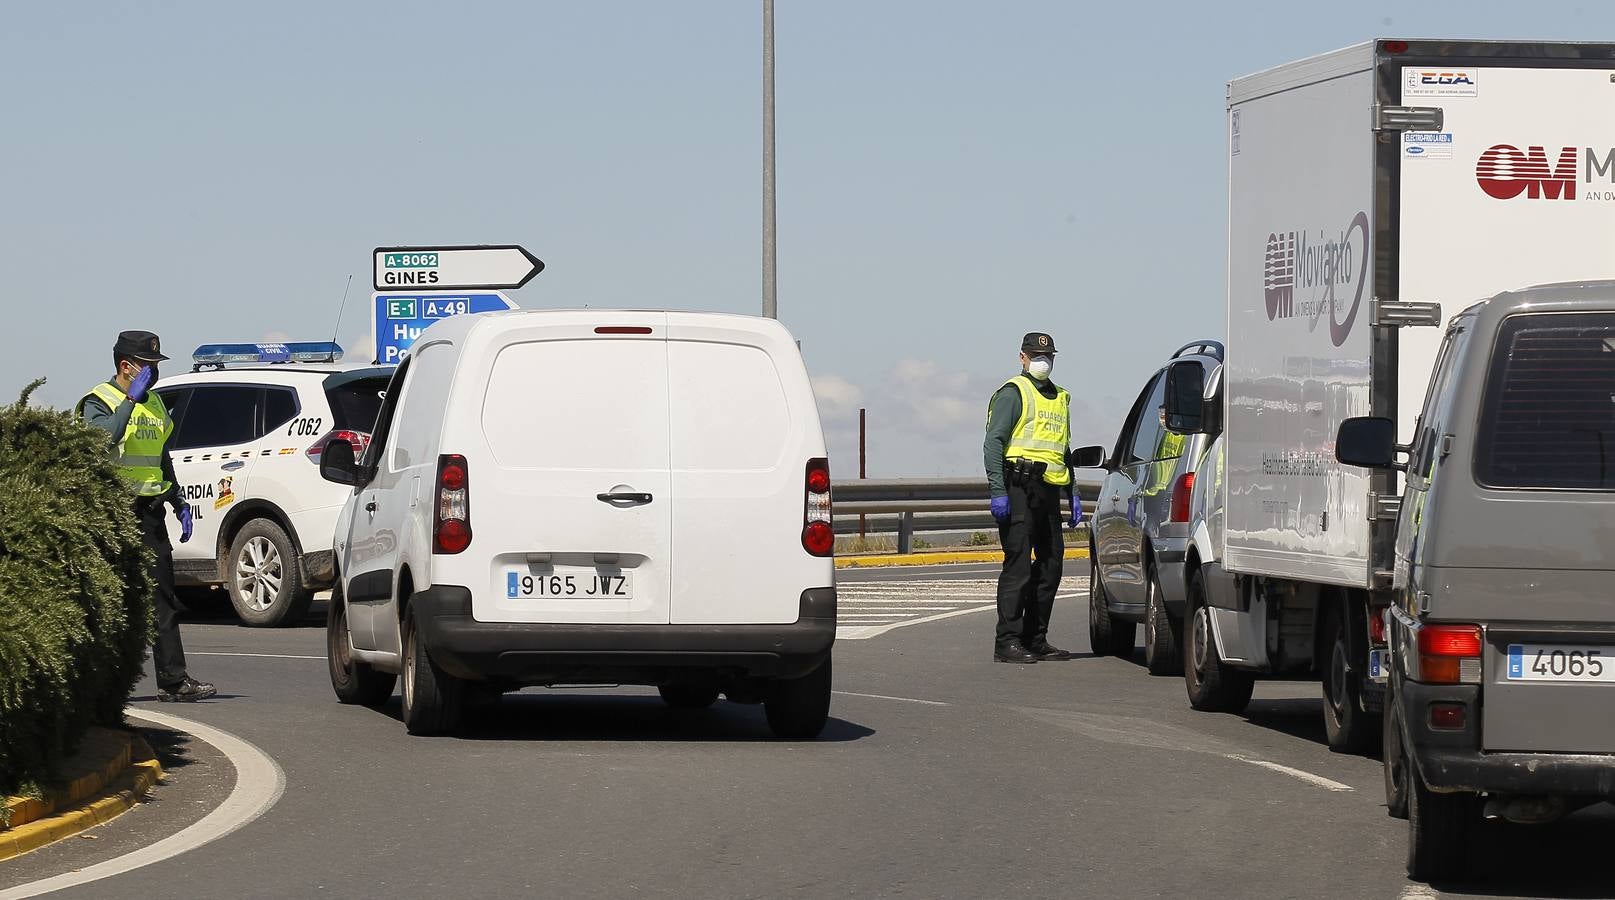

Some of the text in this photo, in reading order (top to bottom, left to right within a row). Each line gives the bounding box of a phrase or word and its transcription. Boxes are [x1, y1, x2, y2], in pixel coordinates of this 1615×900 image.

[1421, 73, 1474, 84] EGA
[1585, 191, 1600, 201] AN
[386, 254, 437, 267] A-8062
[1295, 229, 1352, 289] Movianto
[384, 271, 439, 285] GINES
[390, 301, 466, 316] E-1 A-49
[394, 324, 425, 340] Hu
[385, 346, 410, 362] Po
[135, 429, 158, 440] CIVIL
[297, 417, 322, 436] 062
[181, 483, 214, 500] ARDIA
[521, 575, 577, 596] 9165
[585, 575, 627, 596] JWZ
[1512, 649, 1603, 677] E 4065
